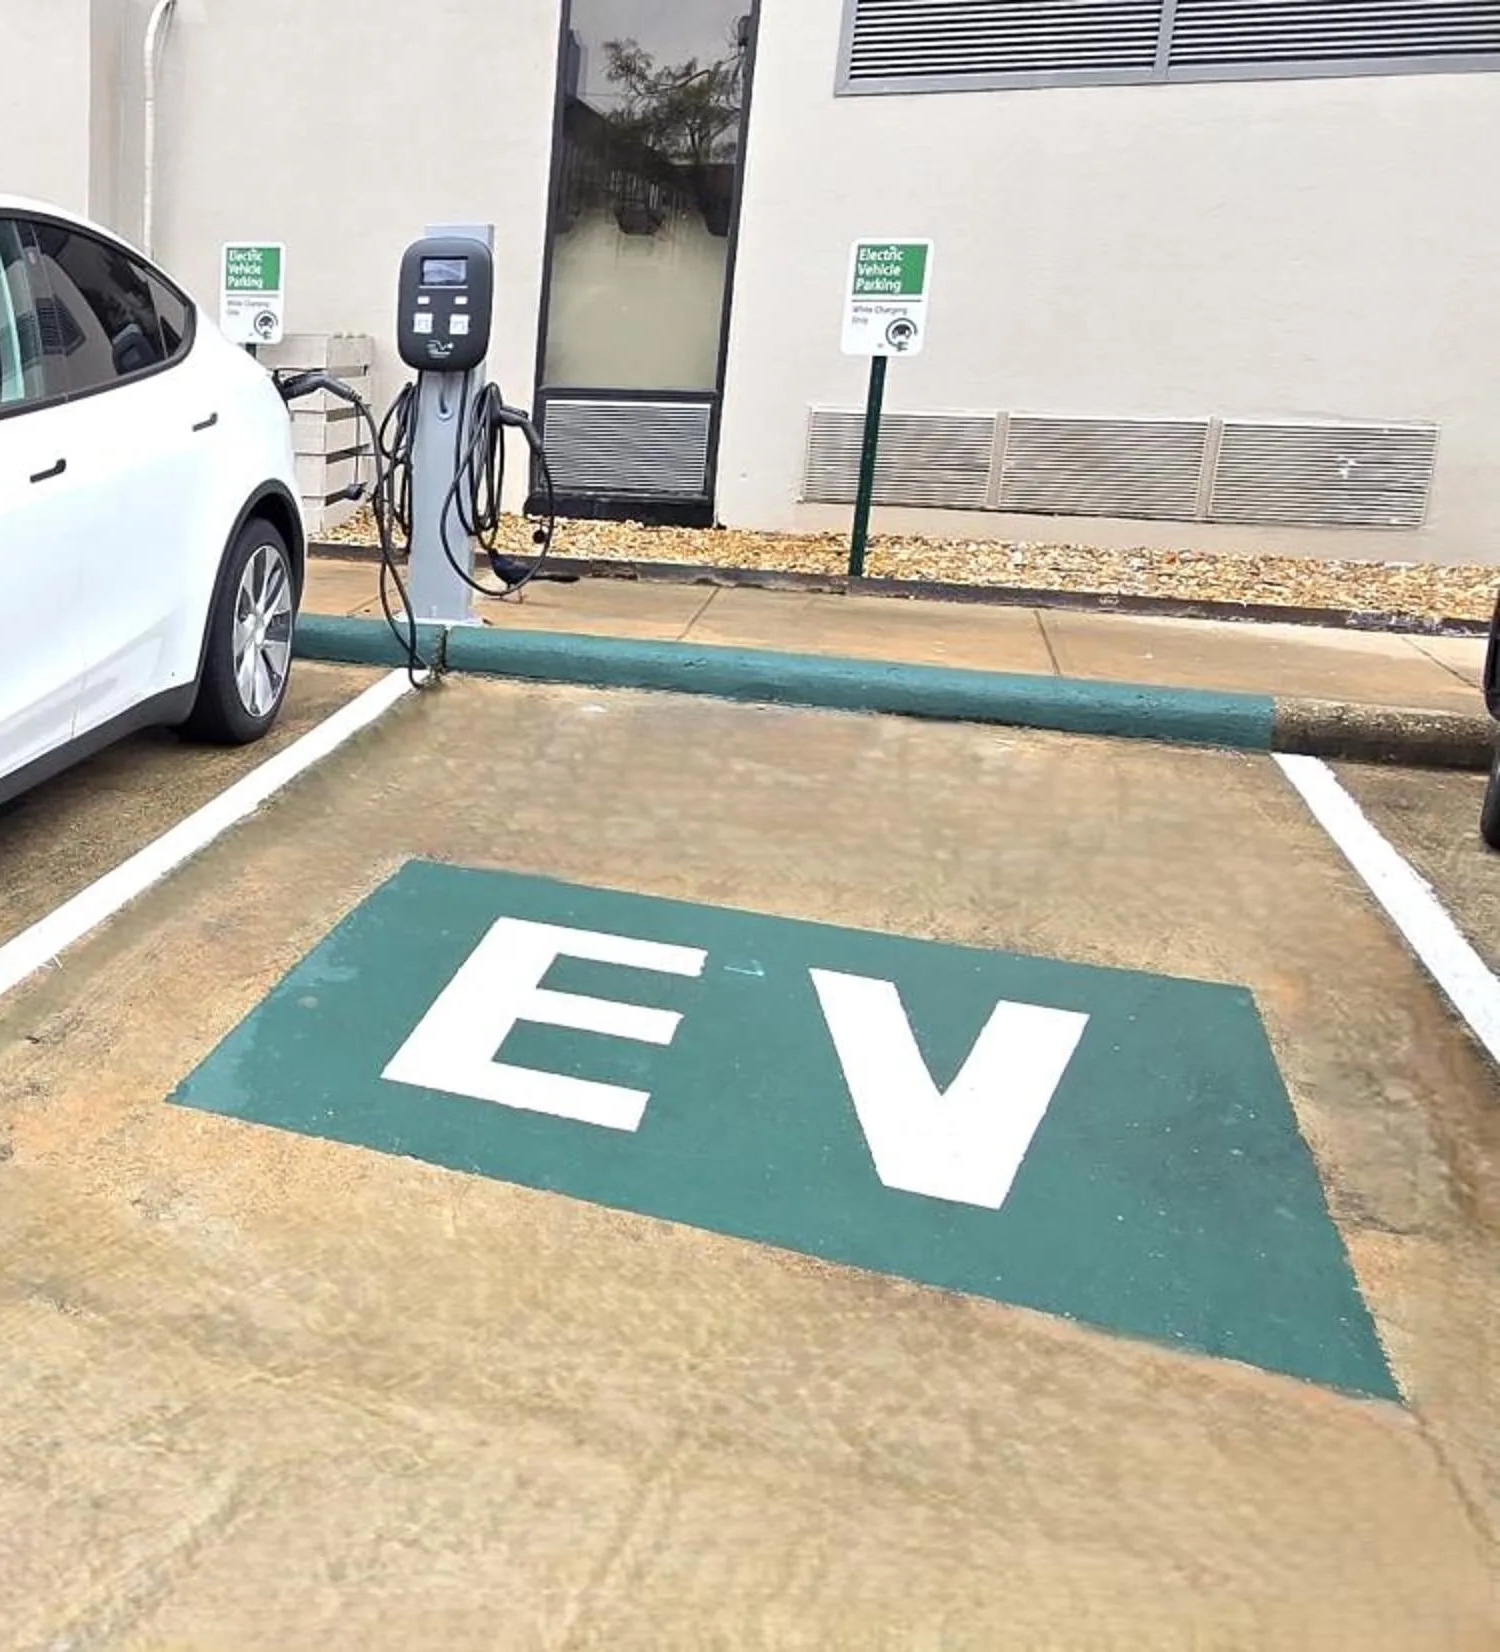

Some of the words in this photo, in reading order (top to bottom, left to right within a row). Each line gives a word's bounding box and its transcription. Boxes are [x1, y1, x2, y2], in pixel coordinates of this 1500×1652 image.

[228, 249, 263, 262] Electric
[859, 247, 904, 261] Electric
[228, 262, 262, 275] Vehicle
[858, 263, 901, 276] Vehicle
[227, 276, 263, 289] Parking
[856, 278, 901, 293] Parking
[852, 305, 872, 314] While
[874, 305, 908, 316] Charging
[380, 915, 1090, 1210] EV
